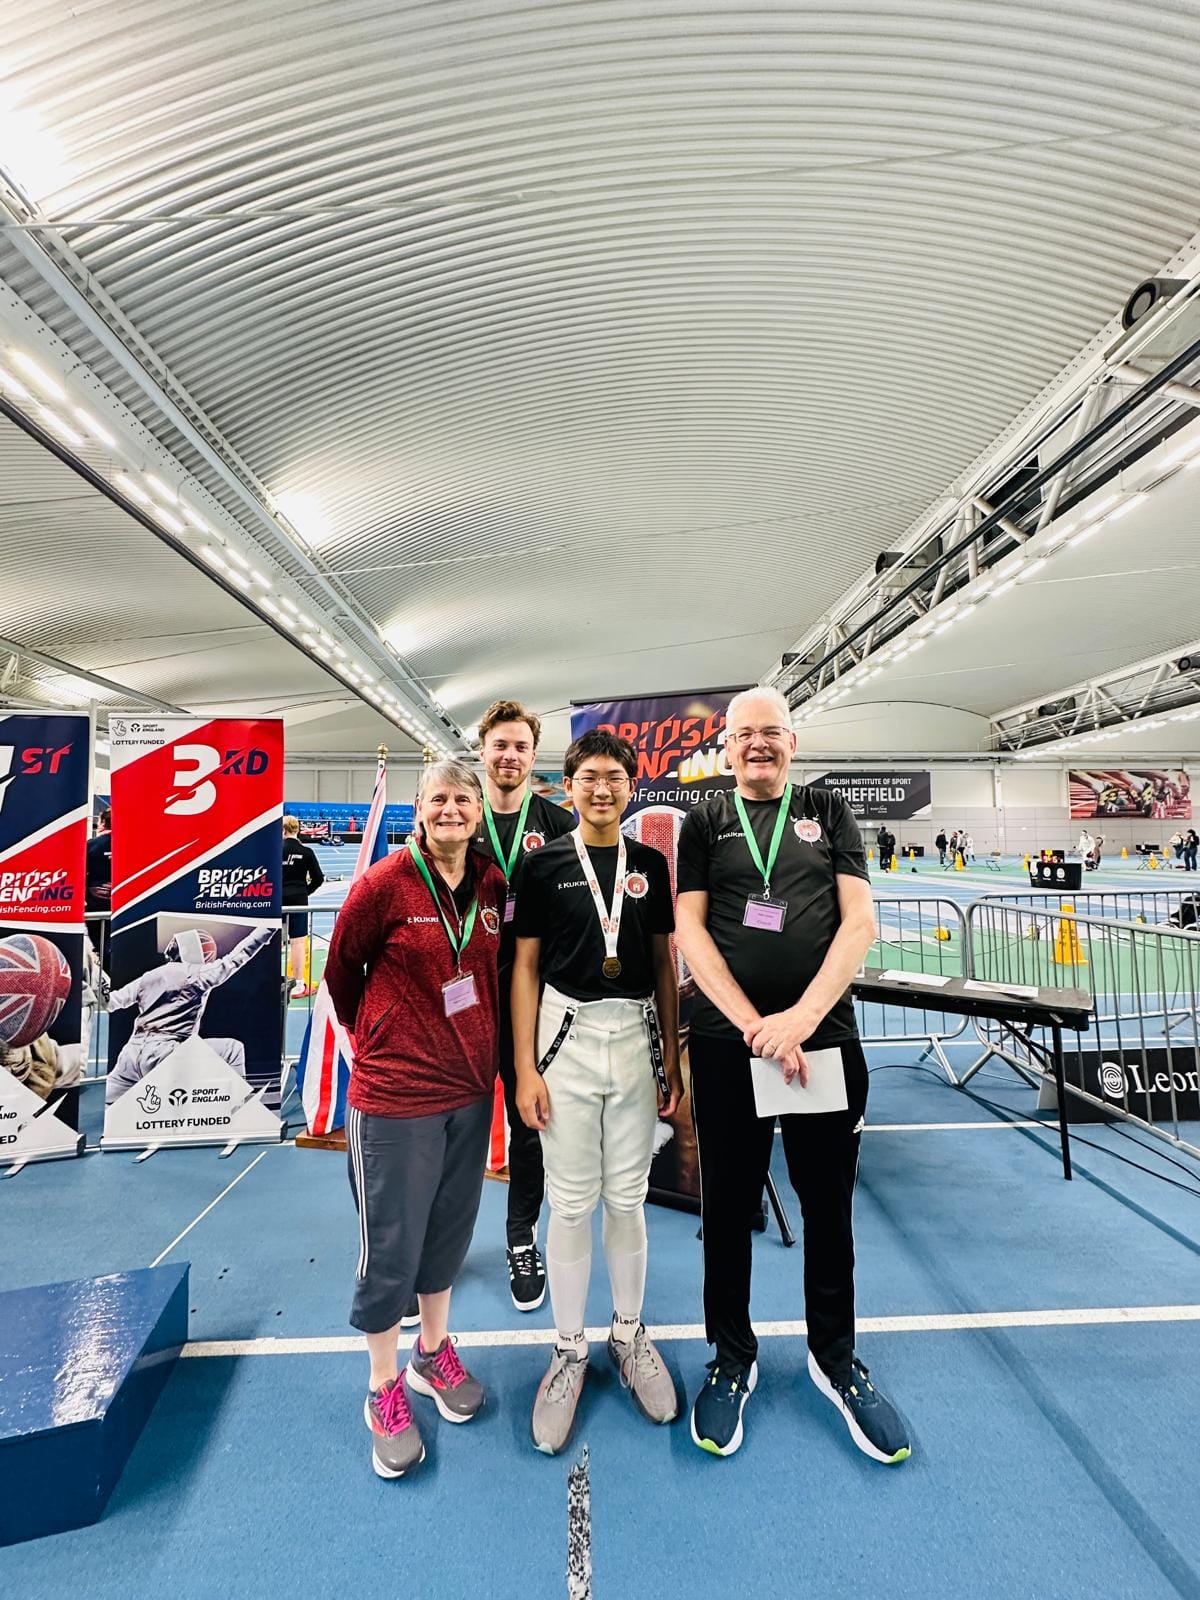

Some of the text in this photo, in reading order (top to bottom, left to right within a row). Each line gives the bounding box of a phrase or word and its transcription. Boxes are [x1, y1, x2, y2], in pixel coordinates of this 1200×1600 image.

[636, 748, 735, 783] NCIN
[0, 868, 68, 887] RITISH
[198, 866, 267, 884] BRITISH
[0, 886, 73, 903] ENCING
[193, 883, 273, 899] FENCING
[195, 901, 271, 909] BritishFencing.com
[191, 1088, 219, 1096] SPORT
[191, 1095, 231, 1103] ENGLAND
[136, 1116, 231, 1130] LOTTERY FUNDED
